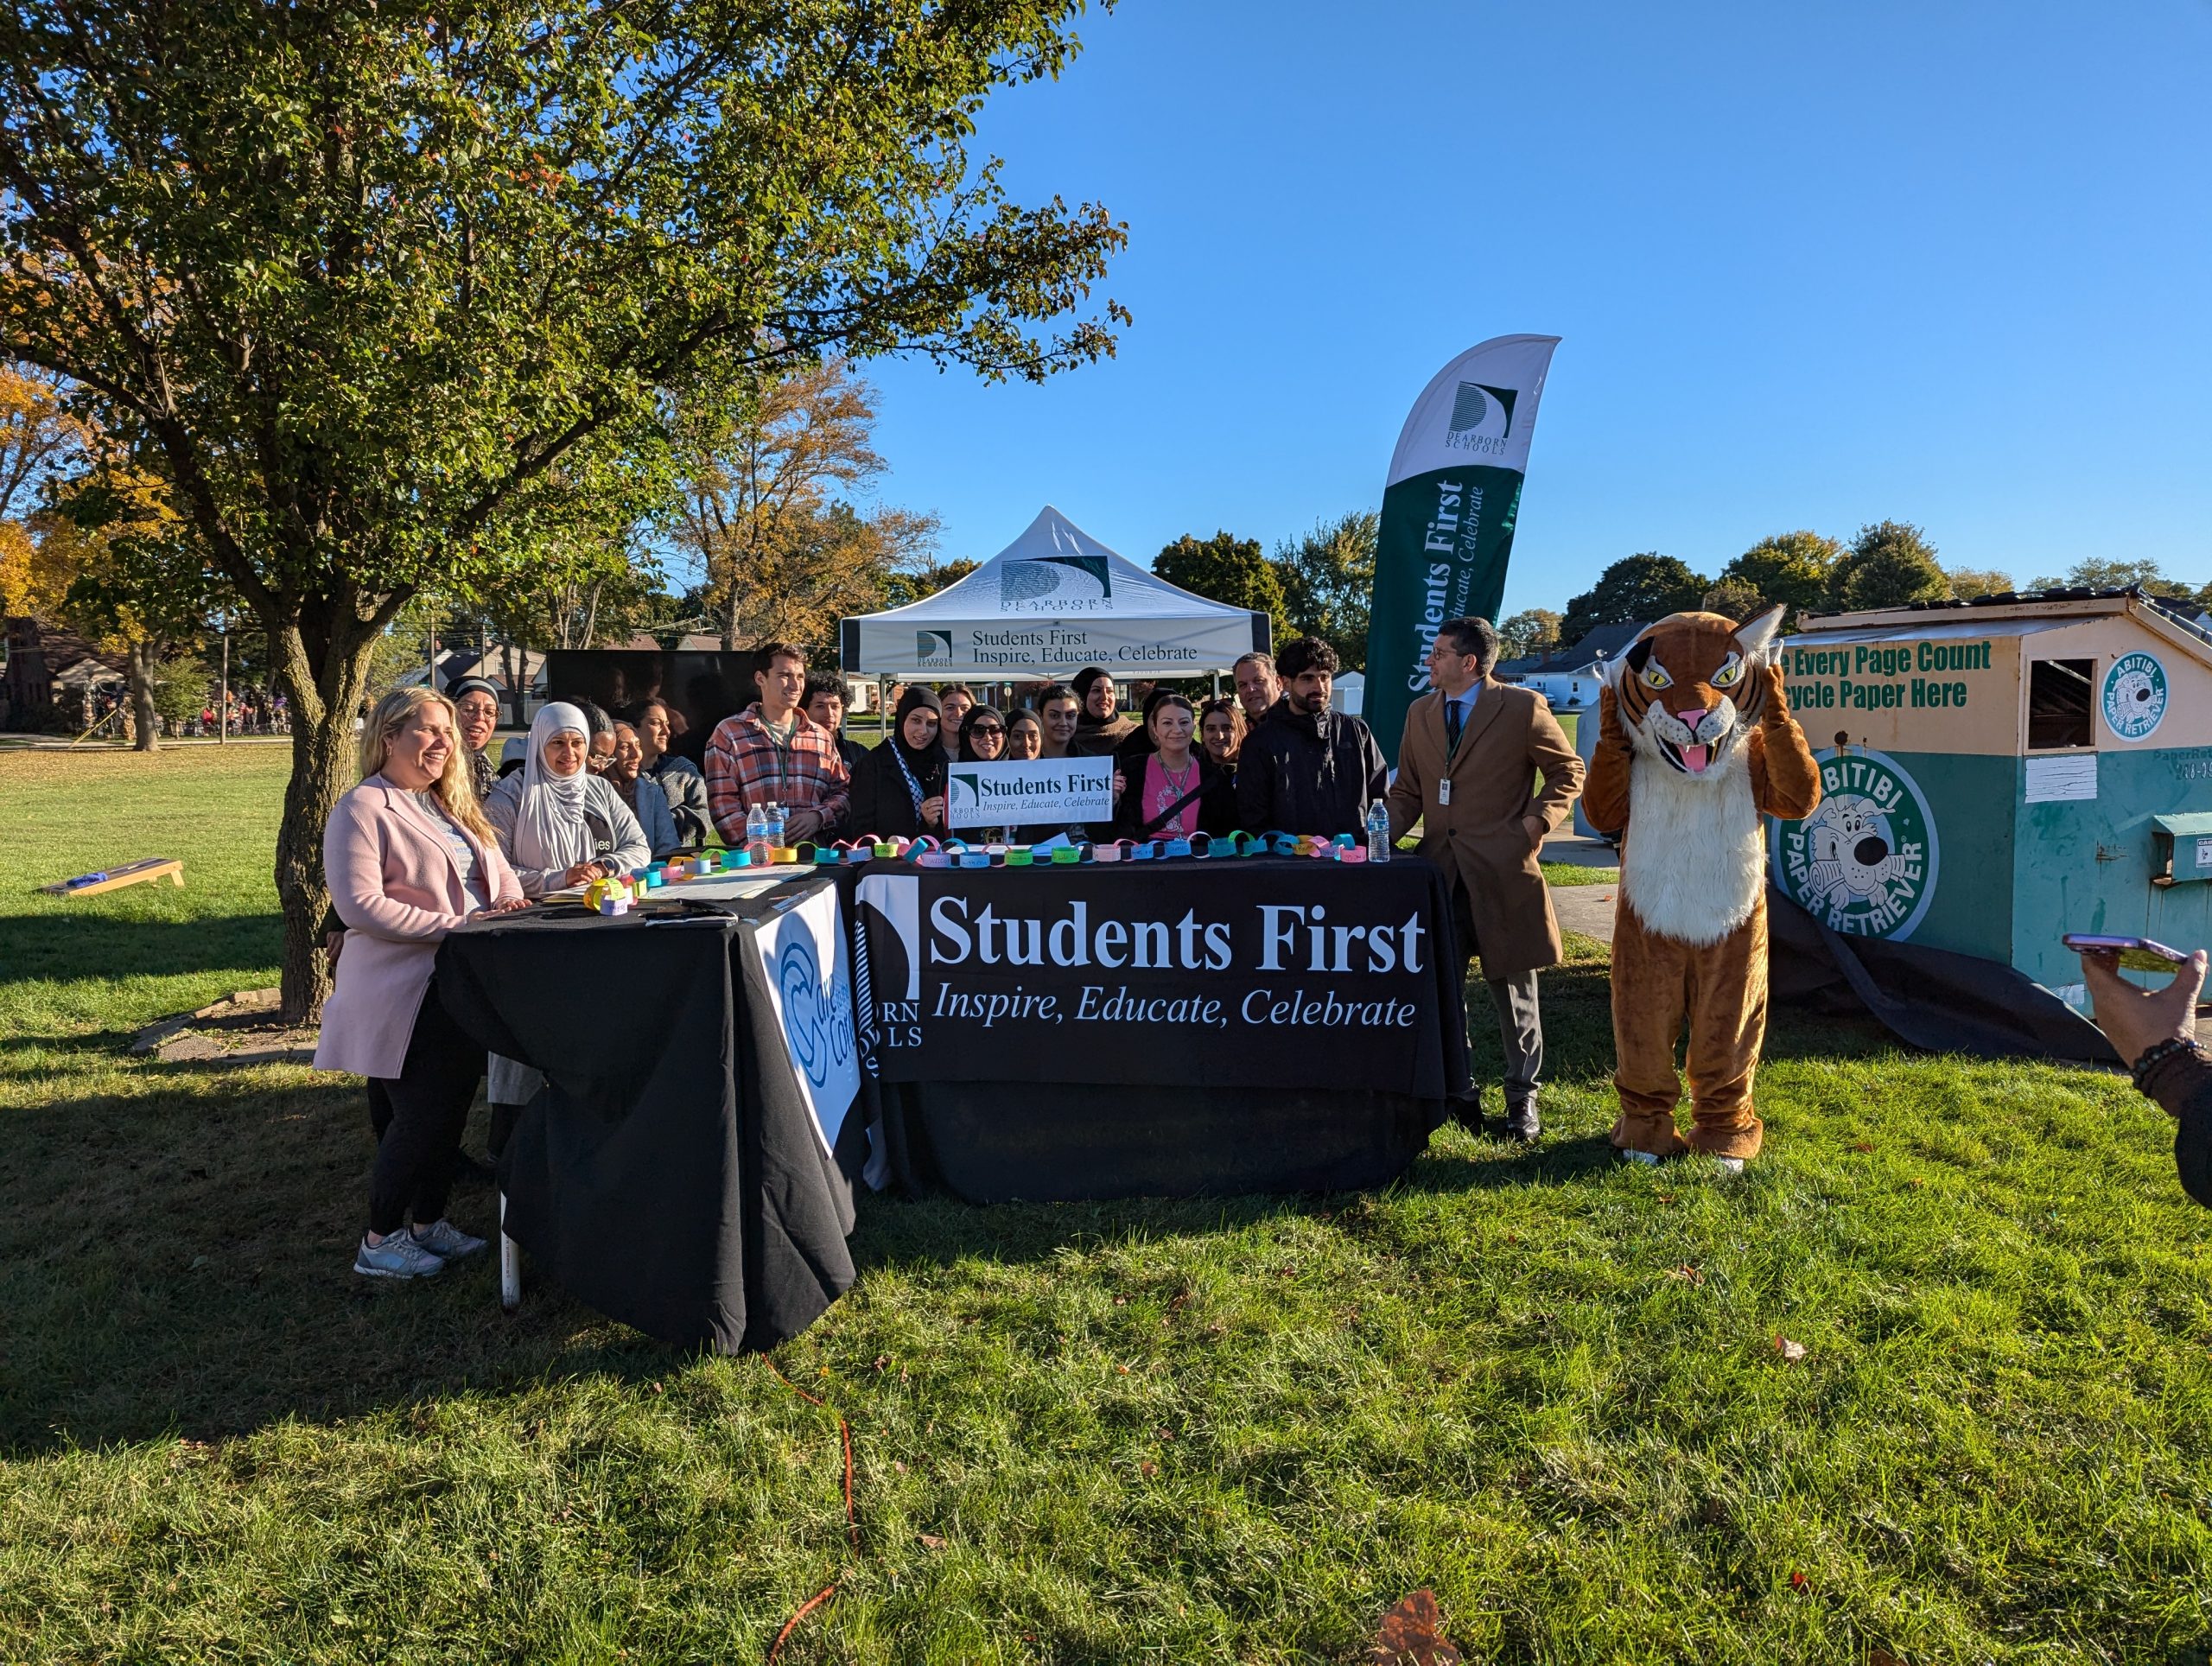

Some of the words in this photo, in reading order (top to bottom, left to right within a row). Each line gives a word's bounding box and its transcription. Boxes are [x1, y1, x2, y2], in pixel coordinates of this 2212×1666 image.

[1445, 439, 1505, 455] SCHOOLS
[1446, 431, 1508, 448] DEARBORN
[1424, 480, 1463, 556] First
[1459, 486, 1484, 563] Celebrate
[1001, 599, 1112, 607] DEARBORN
[972, 630, 1044, 646] Students
[1049, 630, 1088, 645] First
[972, 647, 1035, 666] Inspire,
[1042, 647, 1113, 664] Educate,
[1118, 645, 1198, 661] Celebrate
[1795, 649, 1850, 677] Every
[1855, 646, 1911, 677] Page
[1917, 640, 1992, 671] Count
[2117, 657, 2158, 677] ABITIBI
[1840, 681, 1905, 711] Paper
[1911, 678, 1967, 709] Here
[2107, 692, 2125, 730] PAPER
[2125, 687, 2164, 734] RETRIEVER
[981, 777, 1062, 798] Students
[1067, 774, 1110, 792] First
[1821, 762, 1904, 809] BITIBI
[983, 801, 1018, 813] Inspire,
[1020, 798, 1061, 810] Educate,
[1064, 796, 1110, 807] Celebrate
[1787, 832, 1826, 917] PAPER
[1827, 842, 1923, 937] RETRIEVER
[931, 896, 1232, 970] Students
[1255, 905, 1426, 973] First
[931, 982, 1064, 1027] Inspire,
[1073, 986, 1227, 1028] Educate,
[1242, 989, 1415, 1027] Celebrate
